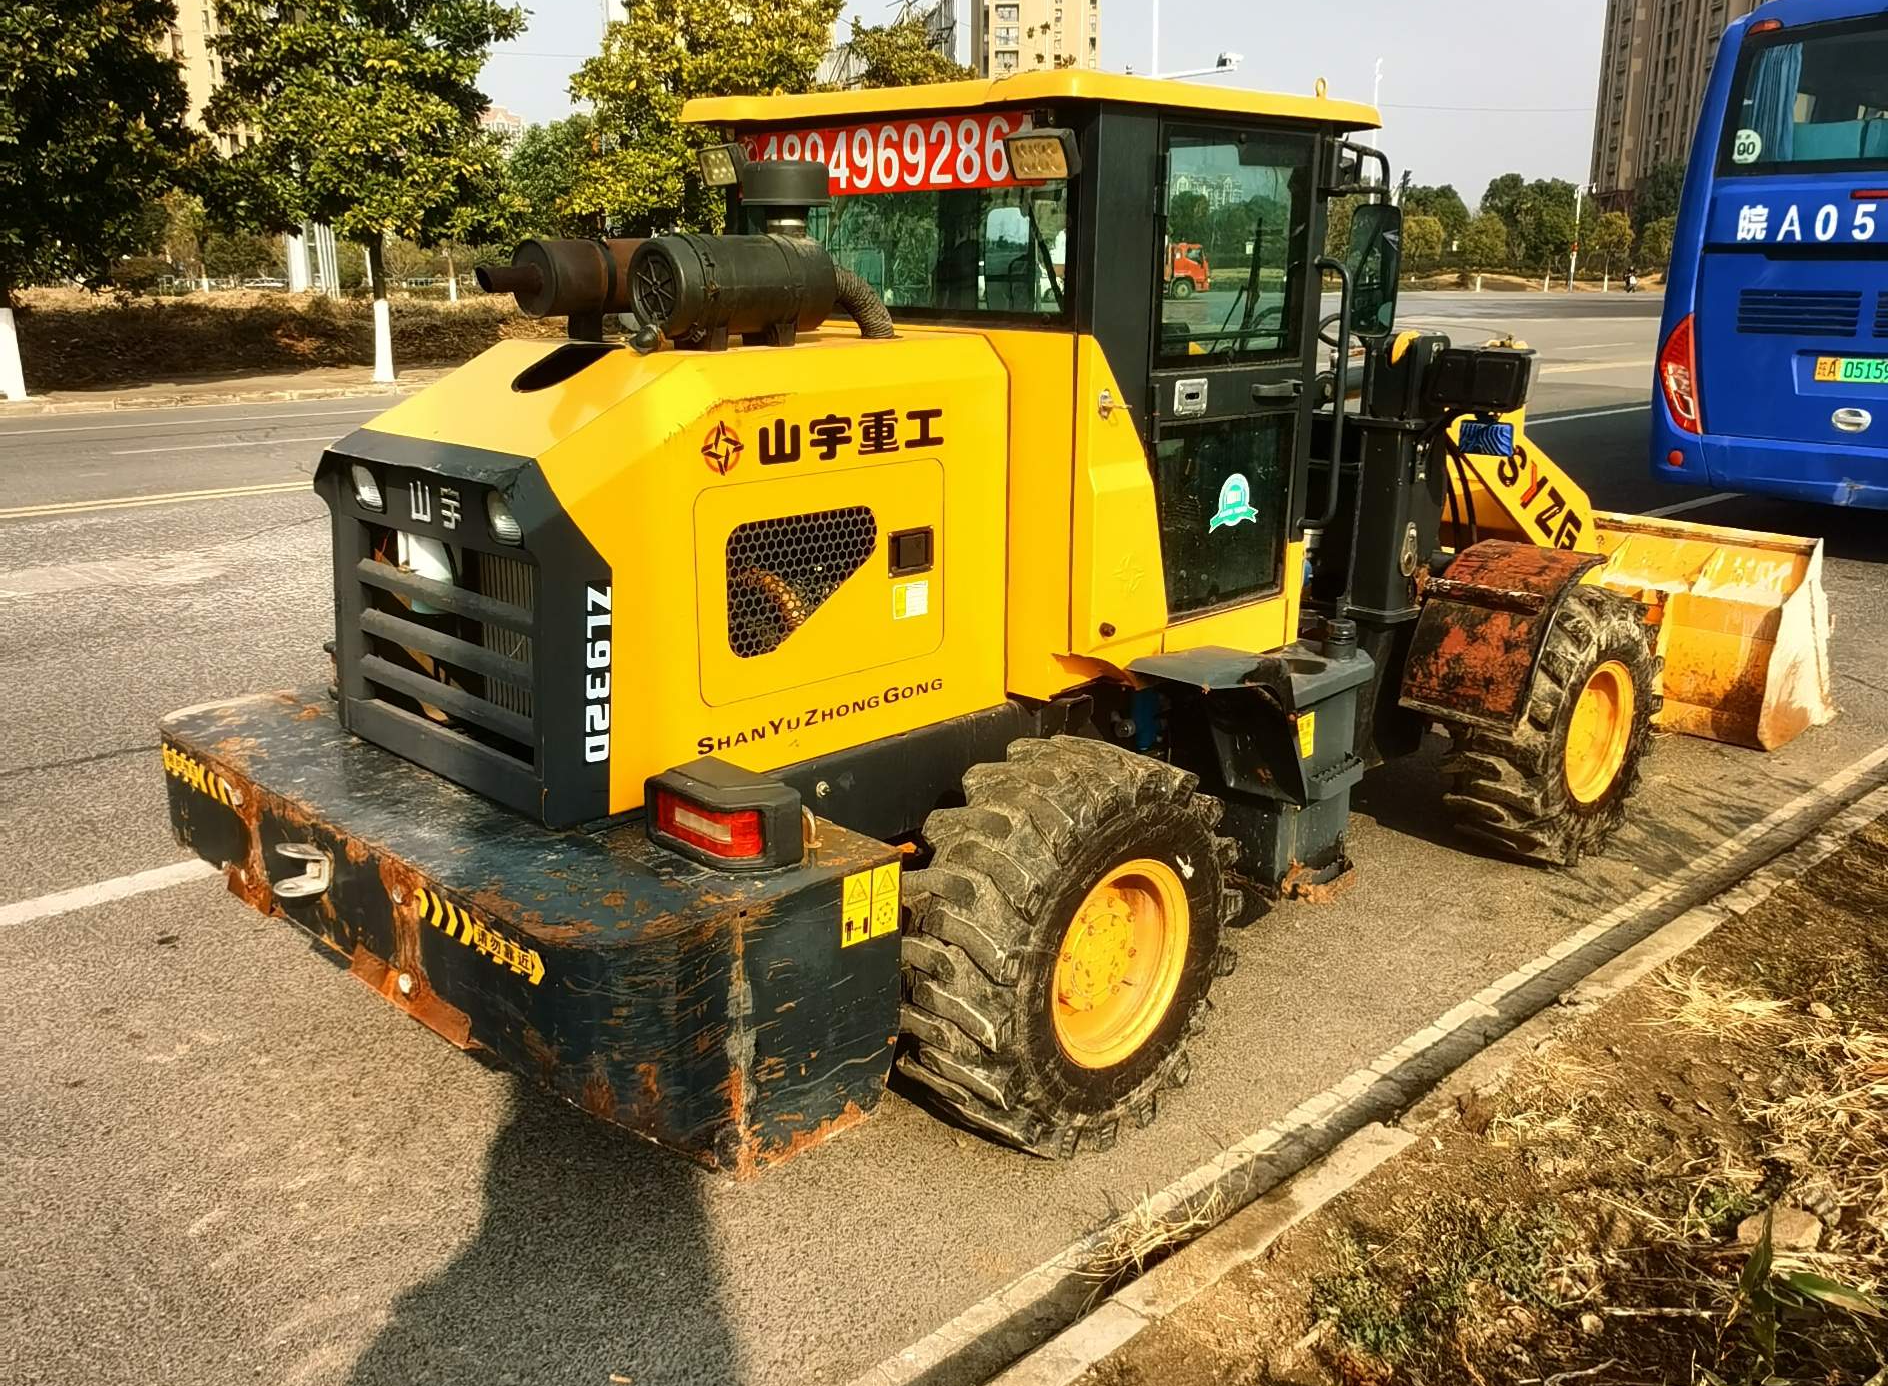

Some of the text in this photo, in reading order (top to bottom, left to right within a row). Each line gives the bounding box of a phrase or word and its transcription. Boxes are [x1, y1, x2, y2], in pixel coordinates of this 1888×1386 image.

[763, 114, 1032, 190] 94969286
[758, 408, 944, 466] 山宇重工
[409, 480, 462, 530] 山宇
